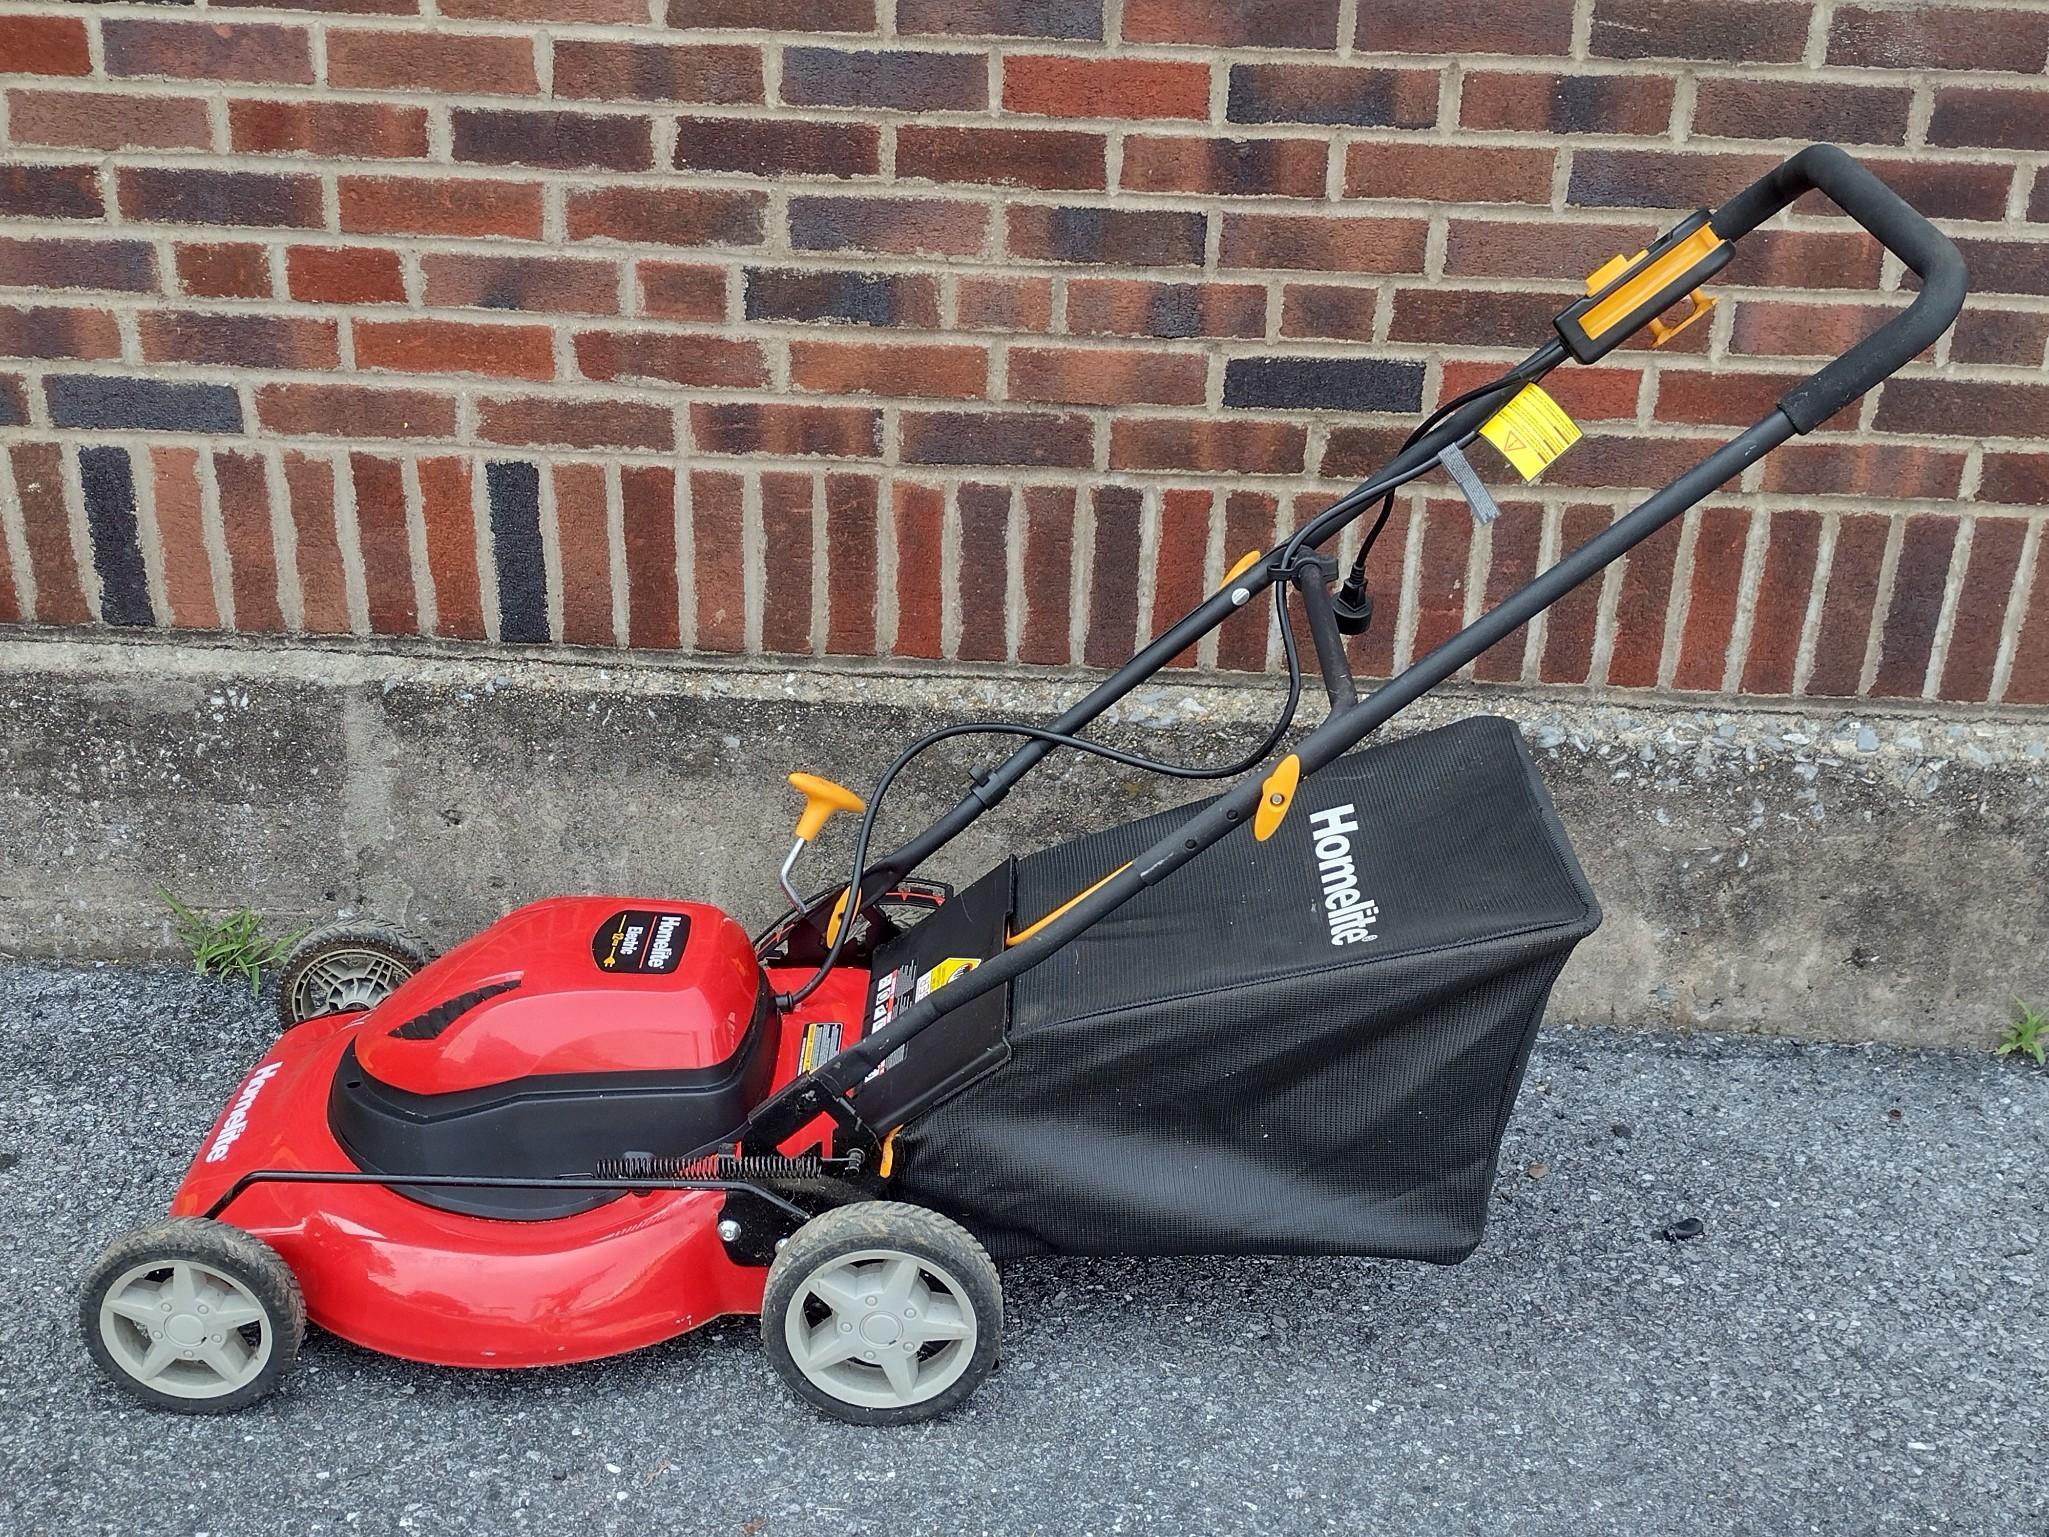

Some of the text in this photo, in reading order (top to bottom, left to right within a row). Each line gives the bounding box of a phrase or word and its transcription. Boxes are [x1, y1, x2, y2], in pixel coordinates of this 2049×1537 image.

[1309, 803, 1379, 946] Homelite
[620, 926, 644, 955] Electric
[648, 916, 682, 968] Homelite
[205, 1061, 284, 1163] Homelite
